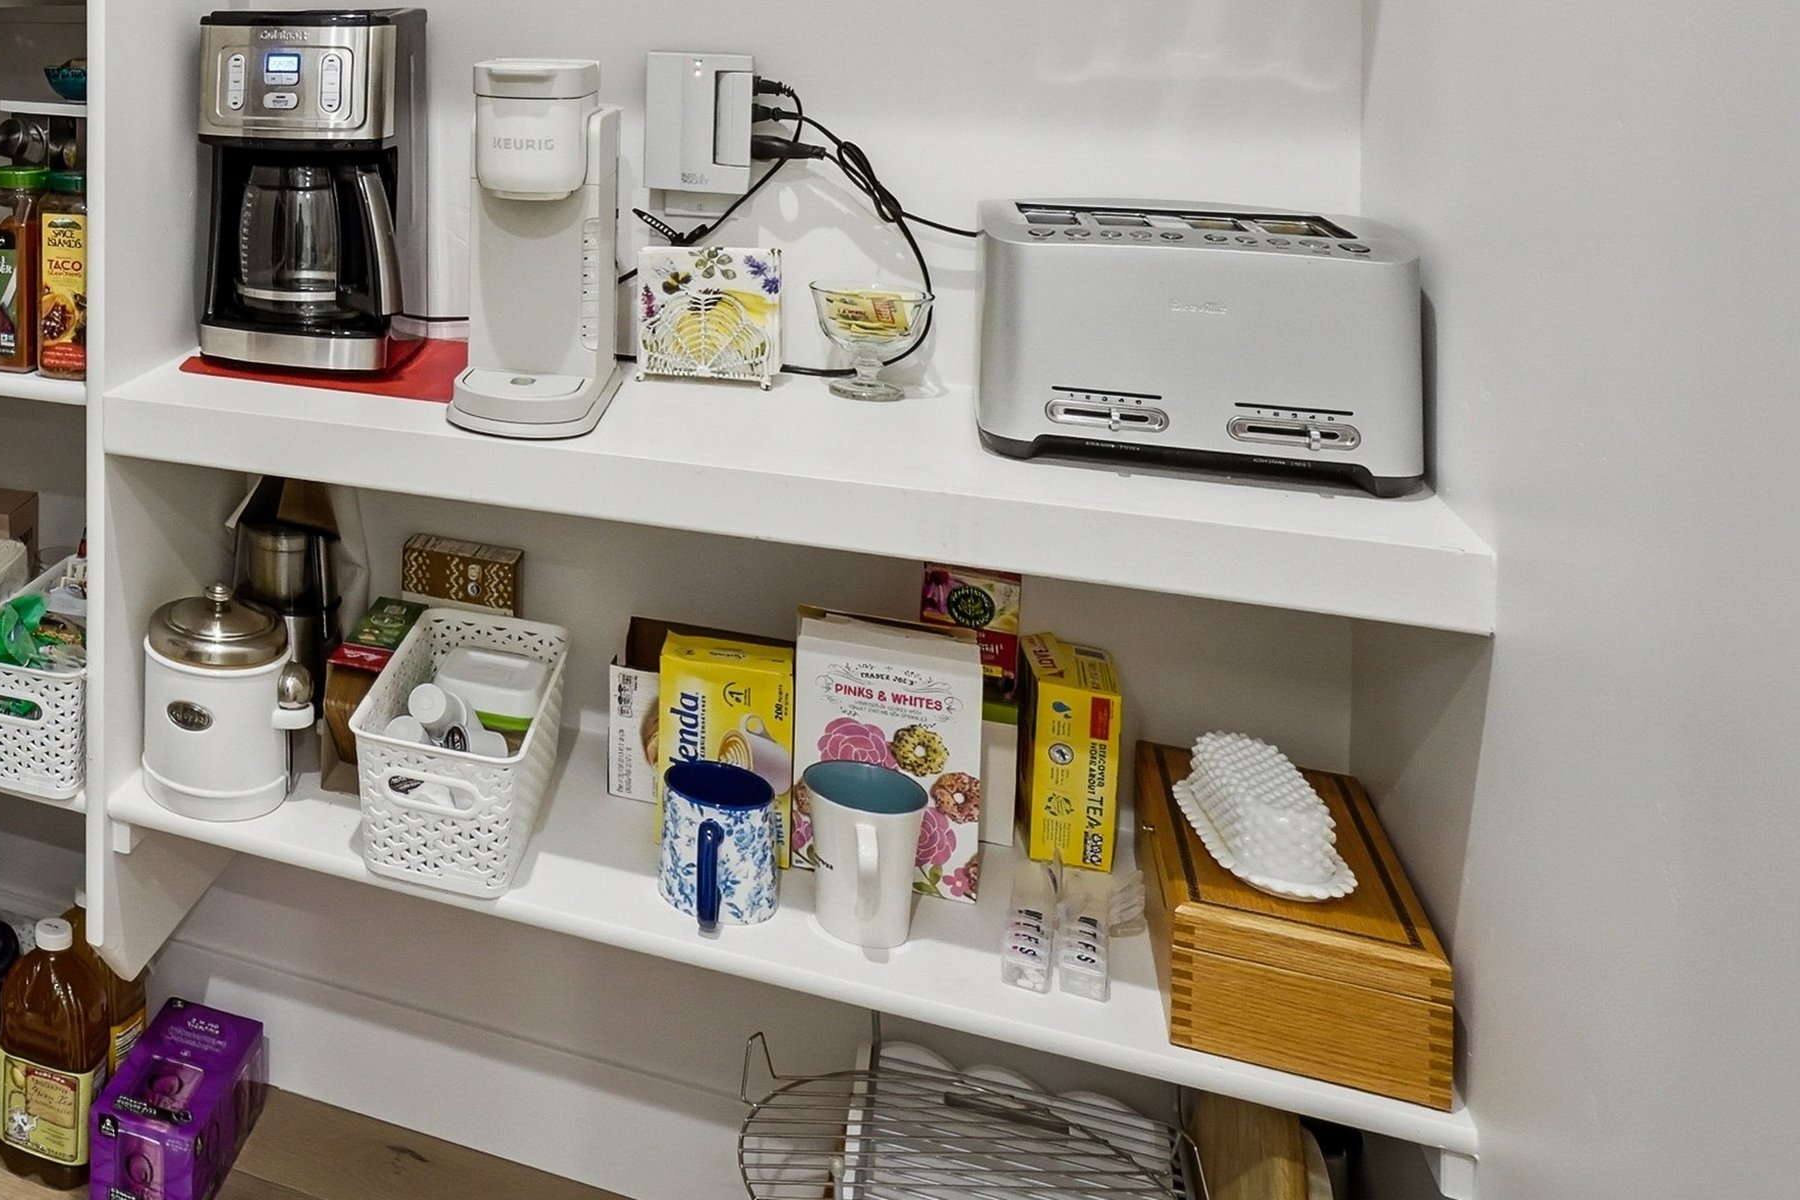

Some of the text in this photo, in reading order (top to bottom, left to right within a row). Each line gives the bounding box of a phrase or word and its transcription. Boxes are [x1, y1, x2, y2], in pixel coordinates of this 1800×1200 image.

[492, 136, 555, 151] KEURIG
[47, 258, 83, 273] TACO
[834, 683, 874, 700] PINKS
[877, 690, 887, 701] &
[891, 692, 943, 712] WHITES
